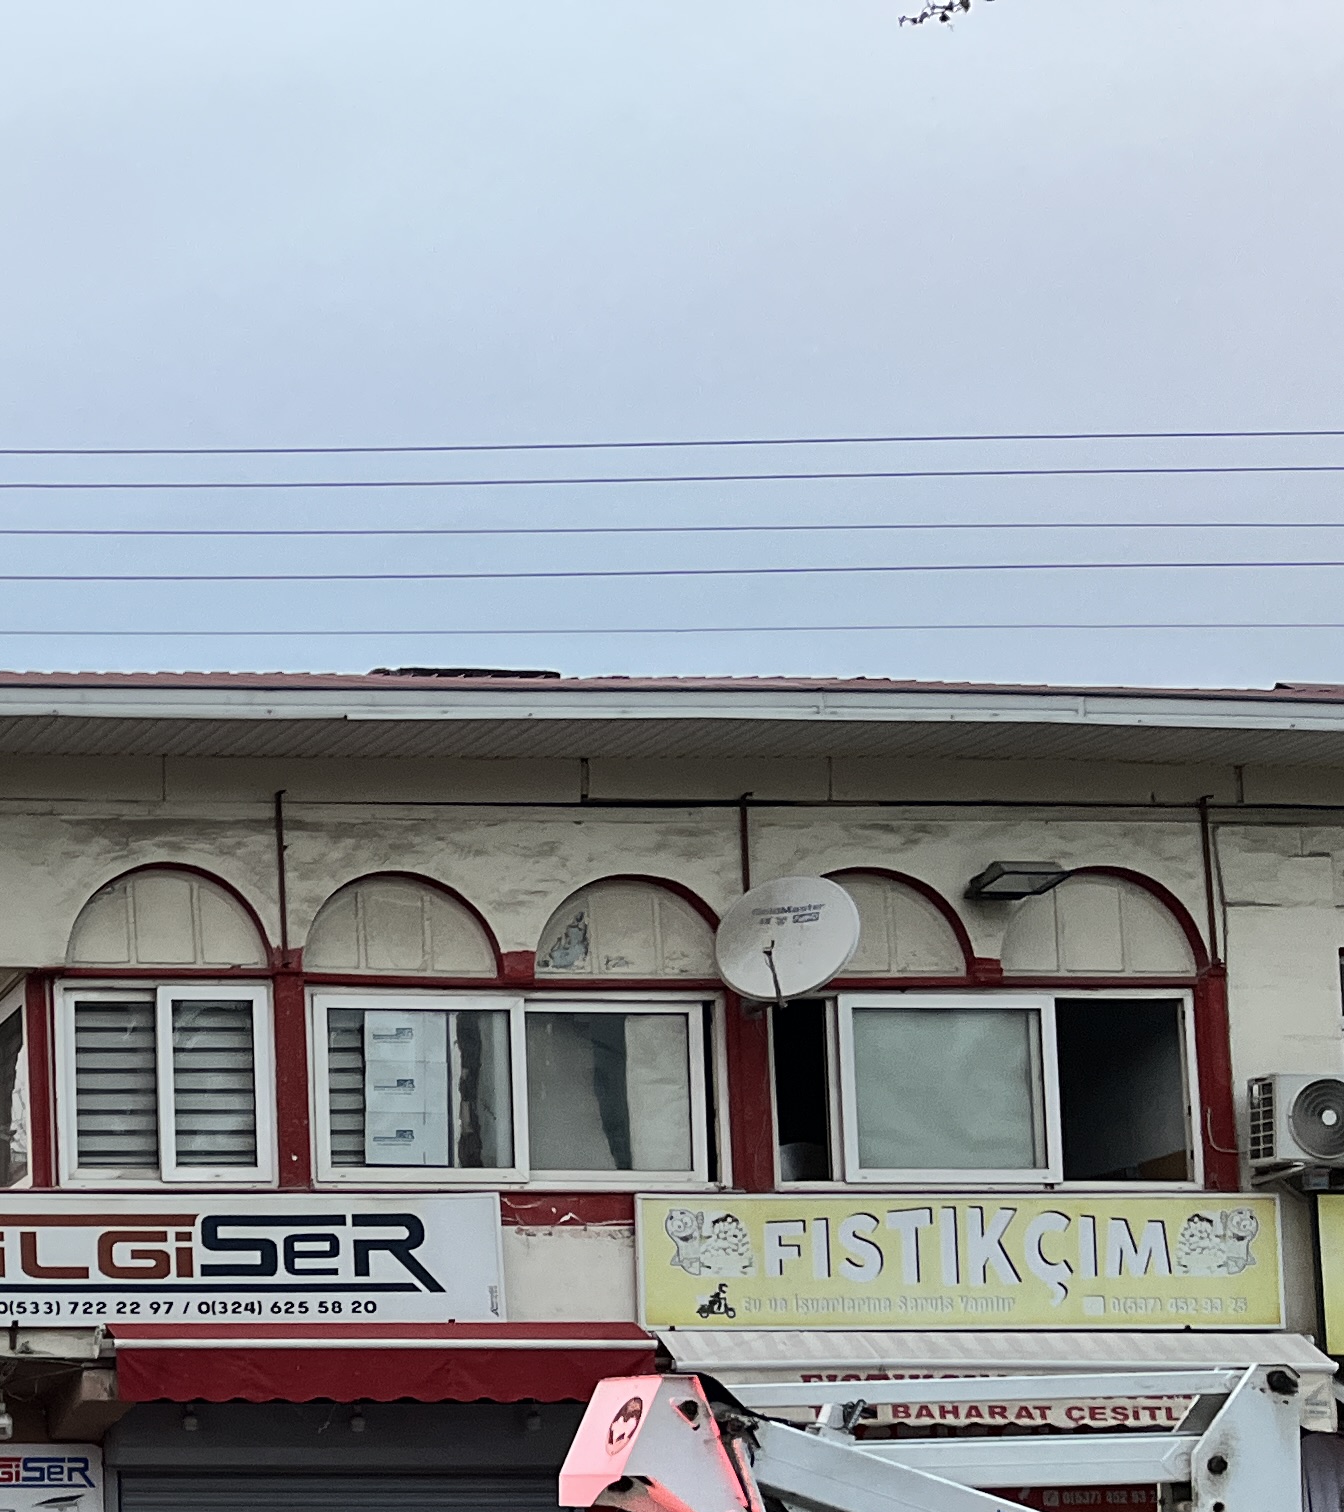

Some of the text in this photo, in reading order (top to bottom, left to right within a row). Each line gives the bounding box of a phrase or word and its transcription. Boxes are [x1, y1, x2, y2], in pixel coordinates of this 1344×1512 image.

[764, 1205, 1173, 1306] FISTIKÇIM
[68, 1301, 107, 1315] 722
[116, 1301, 141, 1315] 22
[149, 1301, 175, 1315] 97
[181, 1300, 191, 1315] /
[197, 1300, 263, 1316] 0(324)
[270, 1300, 310, 1315] 625
[317, 1300, 343, 1315] 58
[351, 1300, 378, 1315] 20
[891, 1404, 1052, 1420] BAHARAT
[1065, 1405, 1187, 1425] ÇEŞİTL
